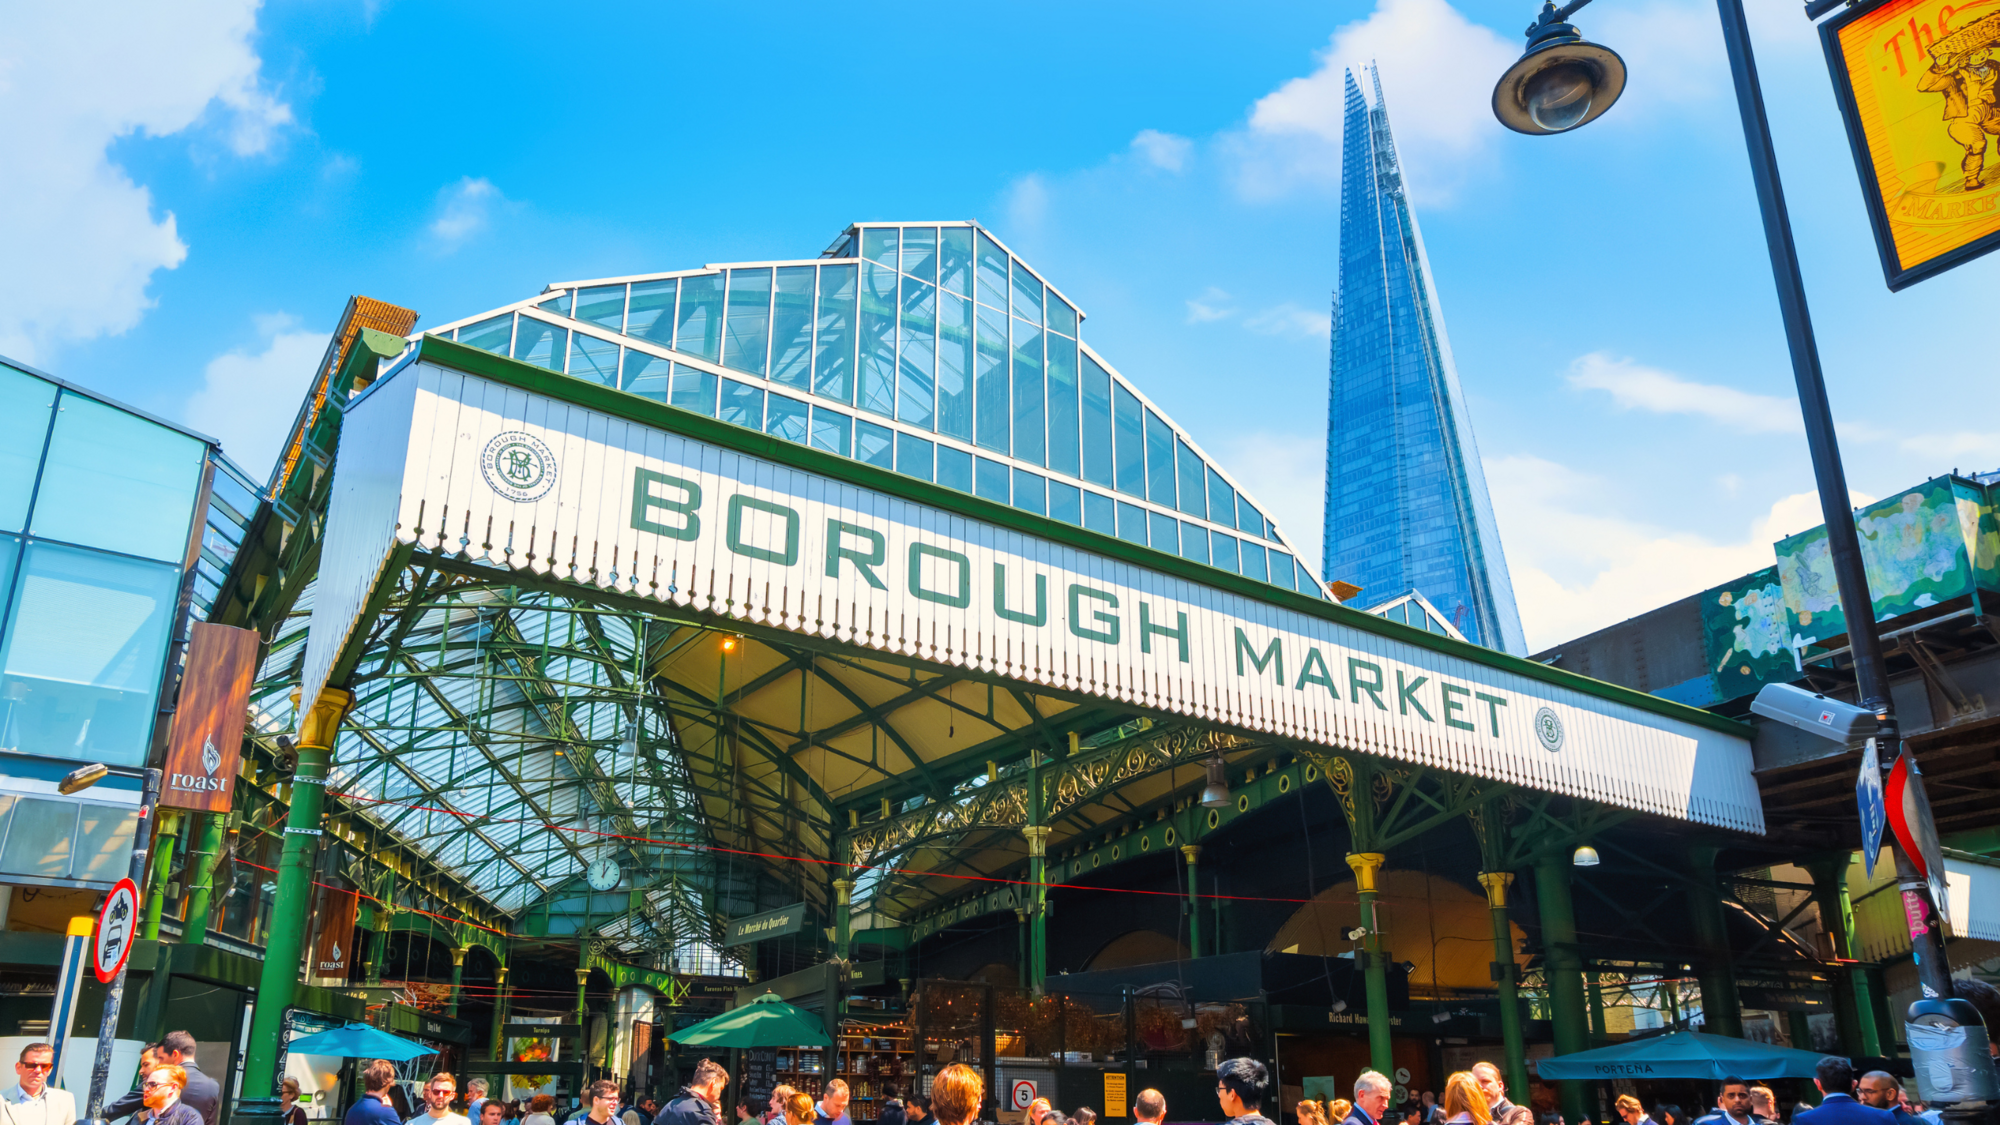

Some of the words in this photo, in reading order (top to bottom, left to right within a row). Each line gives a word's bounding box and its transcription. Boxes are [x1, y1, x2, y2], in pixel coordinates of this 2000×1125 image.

[1883, 4, 1960, 78] The
[1905, 193, 2000, 221] MARKE
[486, 435, 527, 470] BOROUGH
[531, 441, 553, 484] MARKET
[505, 488, 528, 496] 1756
[630, 466, 1190, 664] BOROUGH
[1235, 627, 1508, 739] MARKET
[171, 773, 228, 792] roast
[737, 925, 744, 936] Le
[745, 919, 762, 934] Marché
[762, 919, 768, 930] du
[768, 914, 790, 930] Quartier
[319, 961, 345, 969] roast
[358, 991, 368, 999] Go
[1328, 1011, 1353, 1024] Richard
[1594, 1063, 1654, 1074] PORTEÑA
[1021, 1090, 1028, 1101] 5
